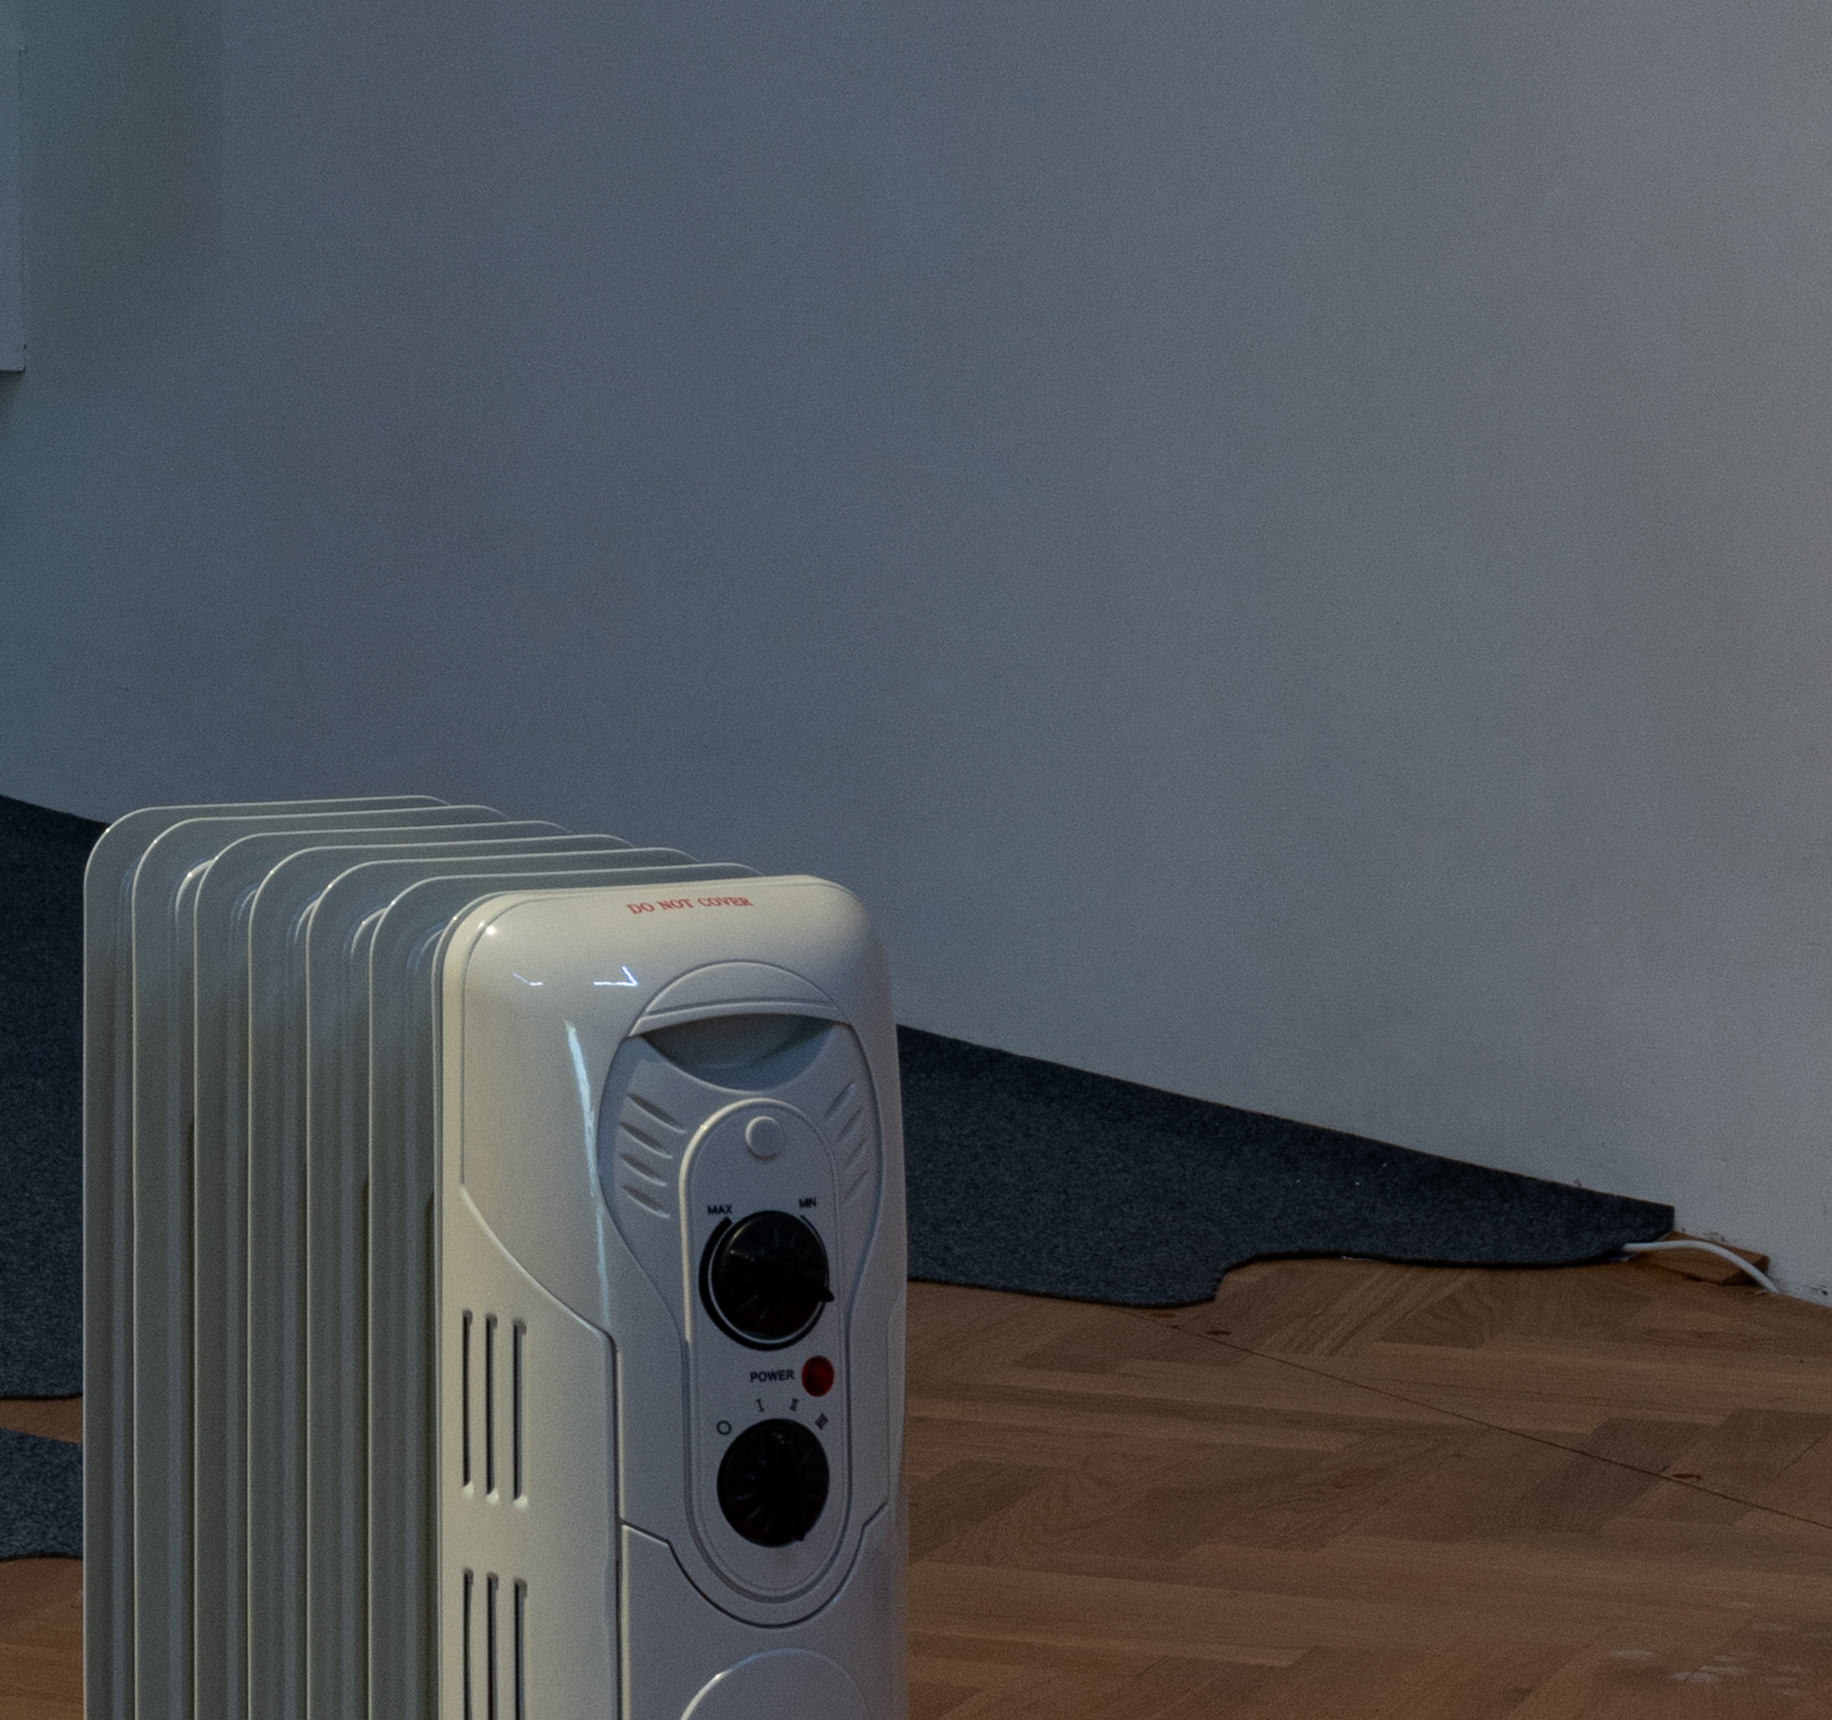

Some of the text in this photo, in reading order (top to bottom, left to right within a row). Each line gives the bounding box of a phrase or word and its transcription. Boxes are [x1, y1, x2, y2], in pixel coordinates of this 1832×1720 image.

[626, 896, 754, 914] DO NOT COVER
[707, 1204, 733, 1215] MAX
[798, 1197, 817, 1209] MIN
[749, 1369, 795, 1383] POWER
